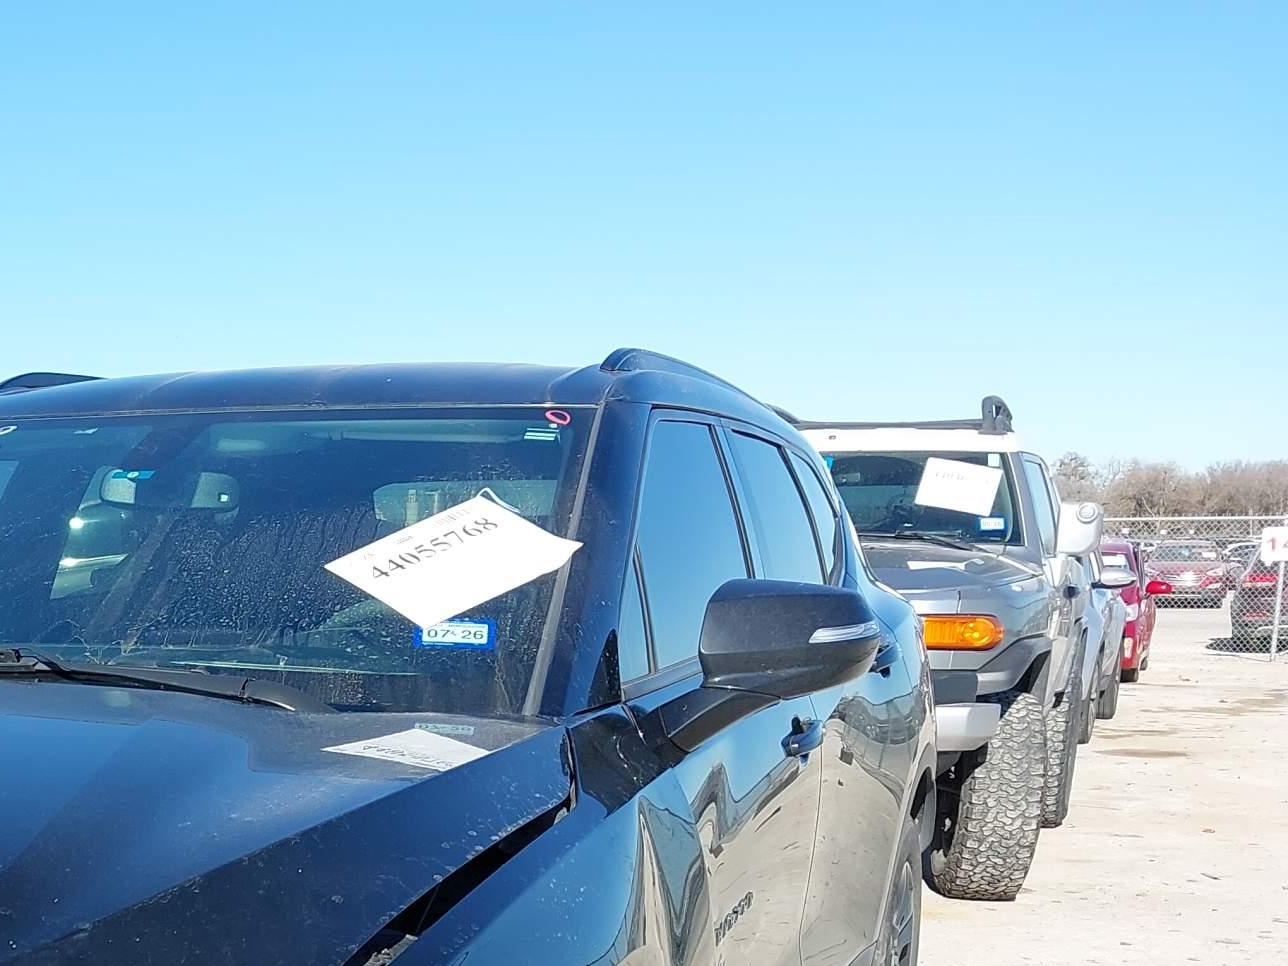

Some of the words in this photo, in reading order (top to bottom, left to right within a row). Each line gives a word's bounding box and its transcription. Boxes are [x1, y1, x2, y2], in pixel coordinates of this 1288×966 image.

[372, 517, 499, 578] 44055768
[427, 628, 451, 639] 07
[461, 629, 484, 640] 26
